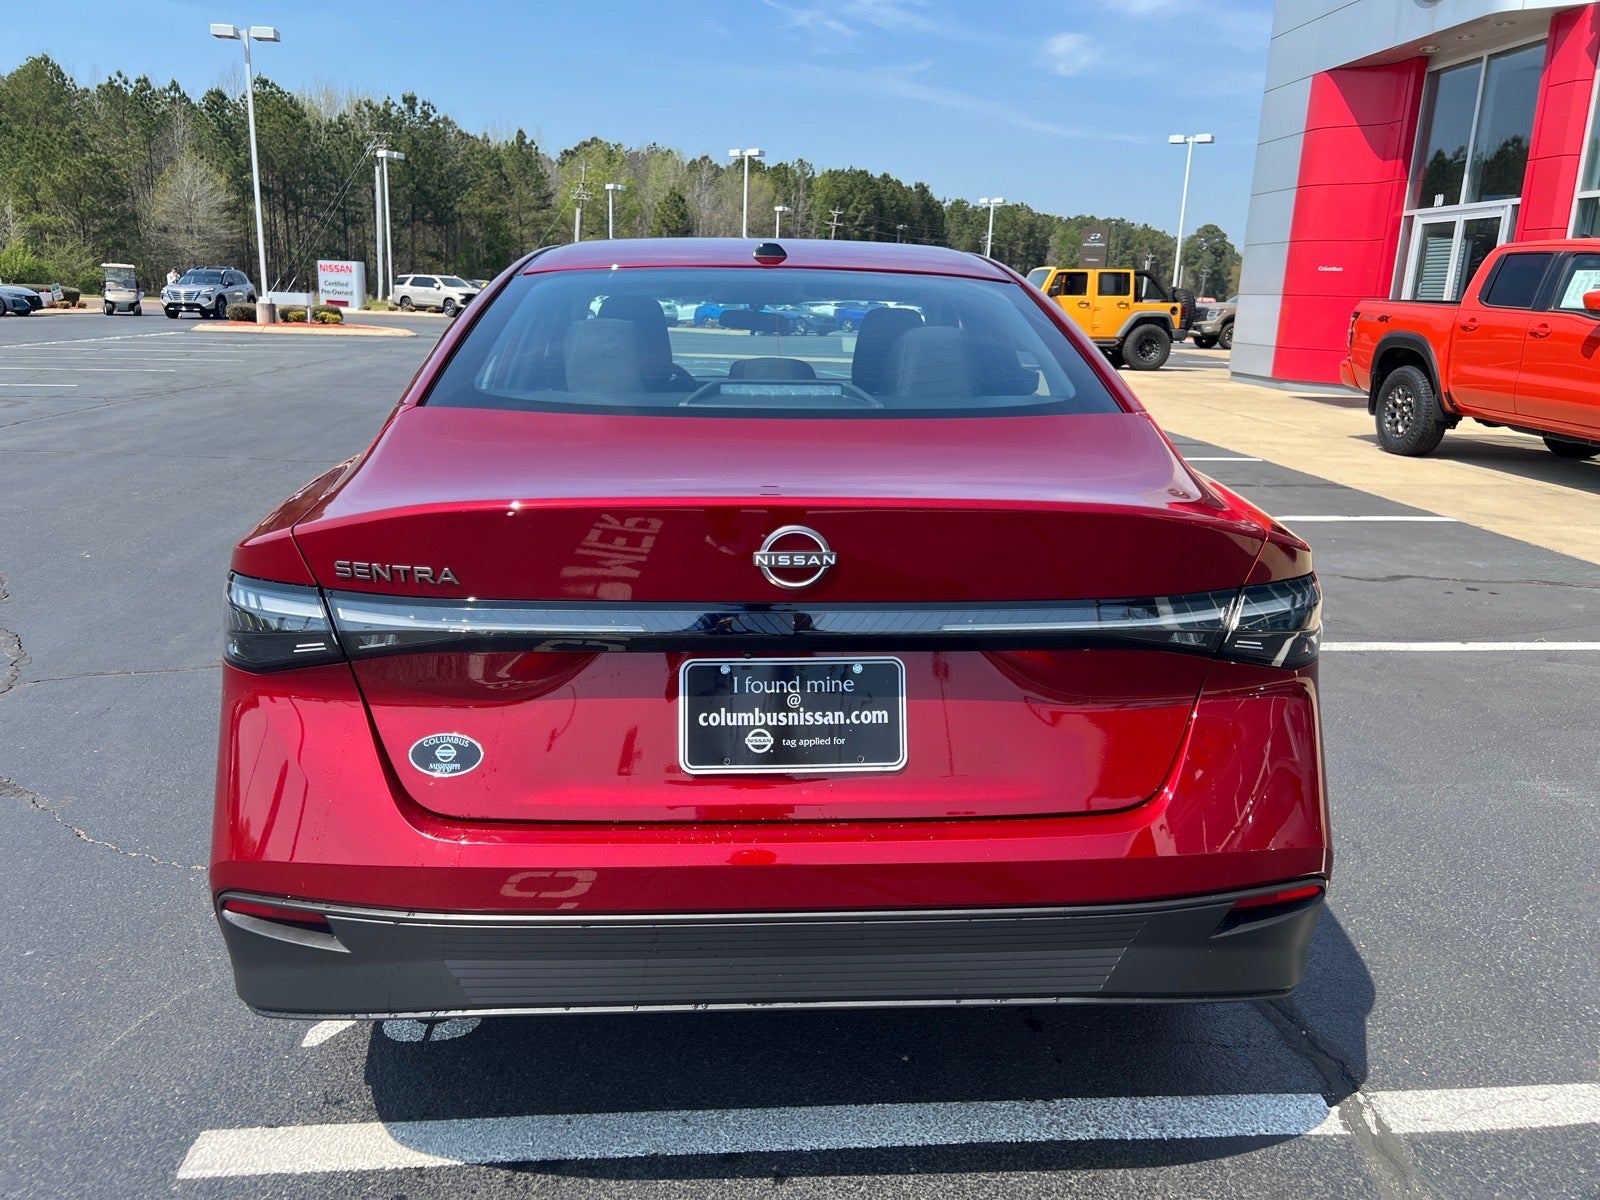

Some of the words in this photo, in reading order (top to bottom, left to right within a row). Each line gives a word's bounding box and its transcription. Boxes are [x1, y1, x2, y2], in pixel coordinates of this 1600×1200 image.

[319, 264, 352, 273] NISSAN
[755, 554, 836, 566] NISSAN
[334, 560, 460, 585] SENTRA
[733, 676, 739, 693] I
[744, 676, 800, 694] found
[806, 679, 855, 693] mine
[786, 693, 801, 708] @
[698, 707, 889, 726] columbusnissan.com
[423, 736, 469, 748] COLUMBUS
[782, 738, 797, 748] tag
[798, 736, 831, 747] applied
[833, 736, 846, 745] for
